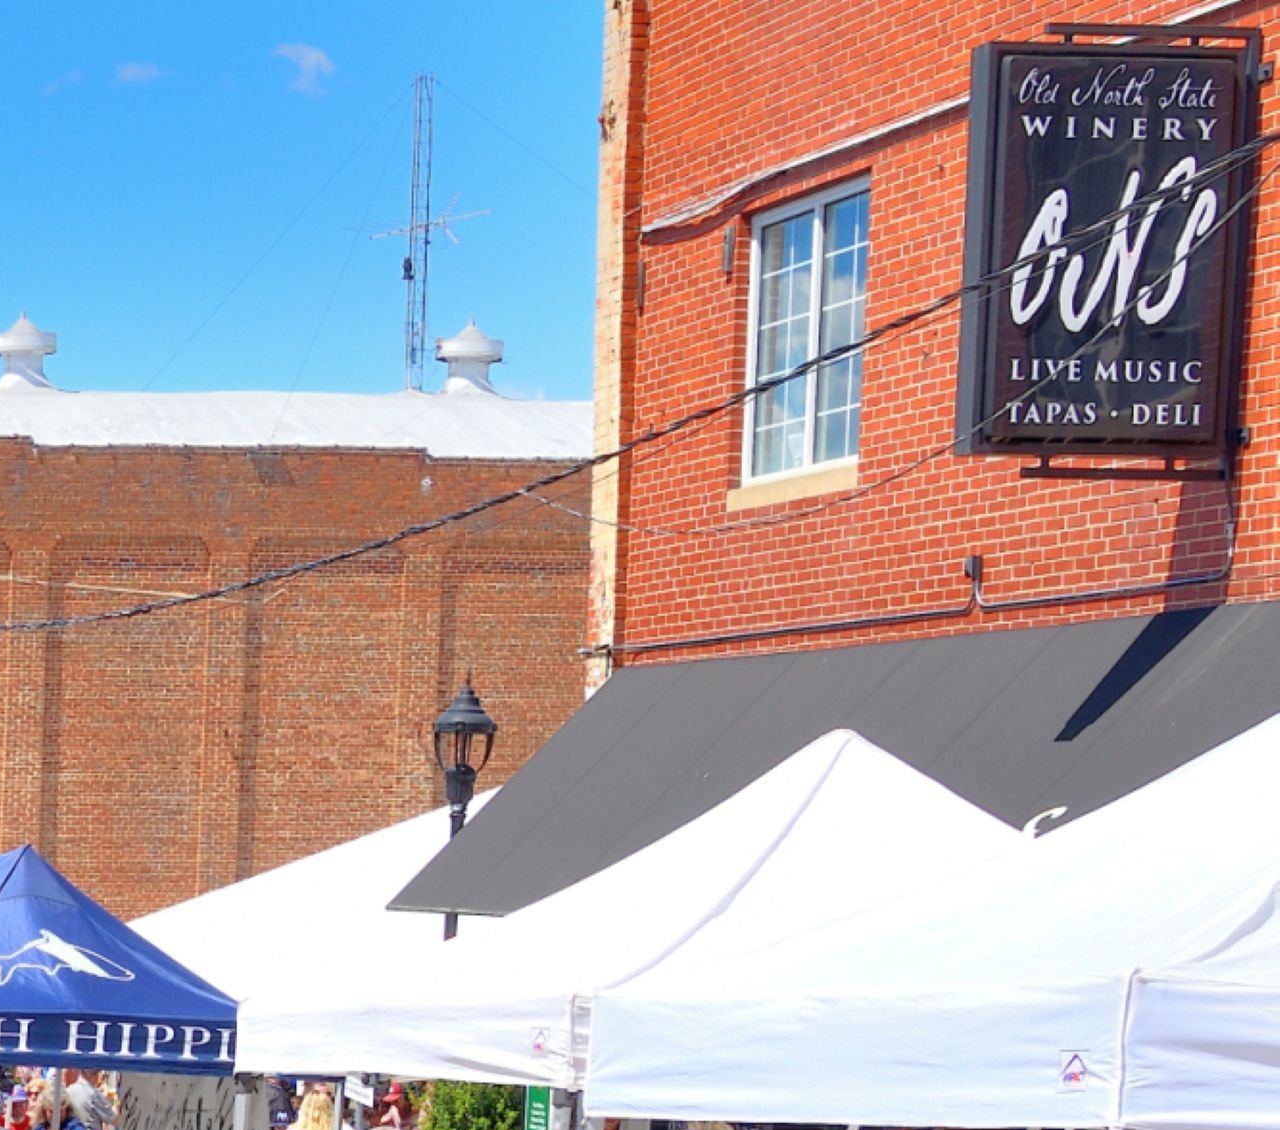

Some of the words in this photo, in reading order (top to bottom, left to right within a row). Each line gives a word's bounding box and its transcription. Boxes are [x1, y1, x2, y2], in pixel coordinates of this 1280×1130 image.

[1018, 66, 1057, 105] Old
[1072, 64, 1155, 107] North
[1158, 68, 1223, 110] State
[1021, 115, 1218, 140] WINERY
[1010, 357, 1082, 382] LIVE
[1094, 360, 1202, 384] MUSIC
[1006, 402, 1096, 424] TAPAS
[1131, 404, 1201, 426] DELI
[64, 1020, 235, 1062] HIPPI
